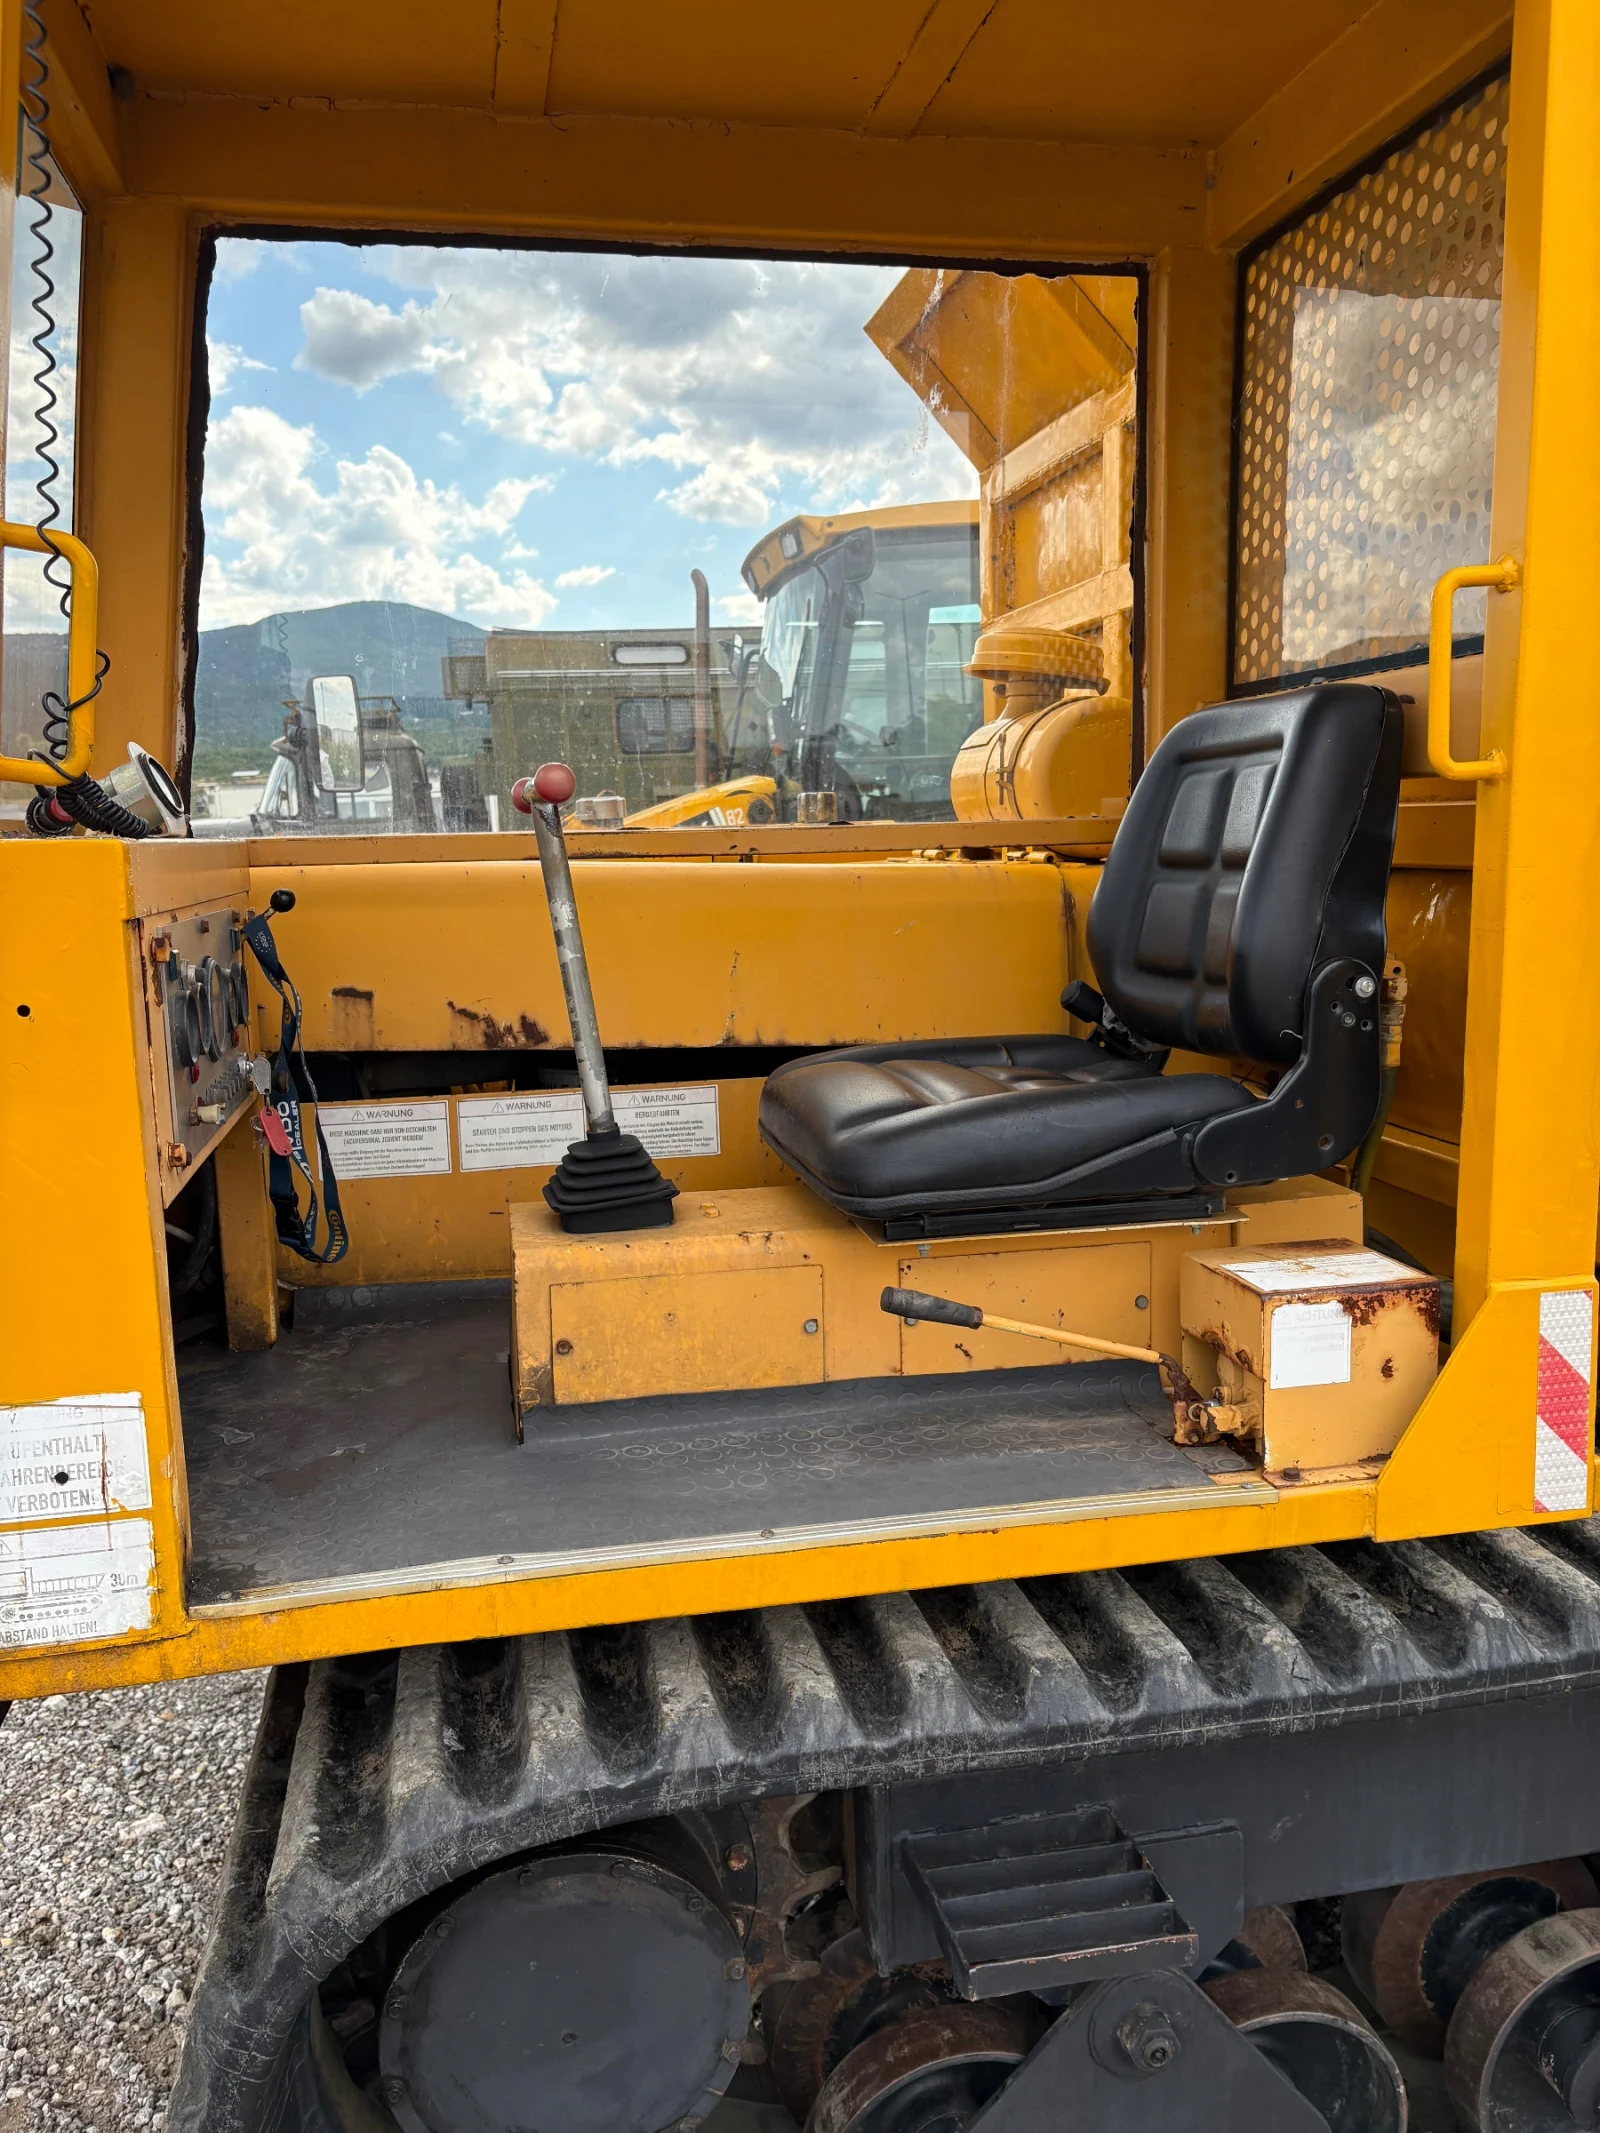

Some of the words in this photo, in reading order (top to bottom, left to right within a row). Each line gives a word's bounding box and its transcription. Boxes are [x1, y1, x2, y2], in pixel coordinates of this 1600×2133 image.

[641, 1093, 686, 1103] WARNUNG
[505, 1100, 551, 1111] WARNUNG
[366, 1108, 413, 1119] WARNUNG
[344, 1128, 369, 1137] MASCHINE
[472, 1128, 497, 1137] STARTEN
[511, 1125, 537, 1134] STOPPEN
[537, 1124, 549, 1132] DES
[549, 1122, 573, 1131] MOTORS
[6, 1488, 97, 1514] VERBOTEN!
[52, 1620, 97, 1638] HALTEN!
